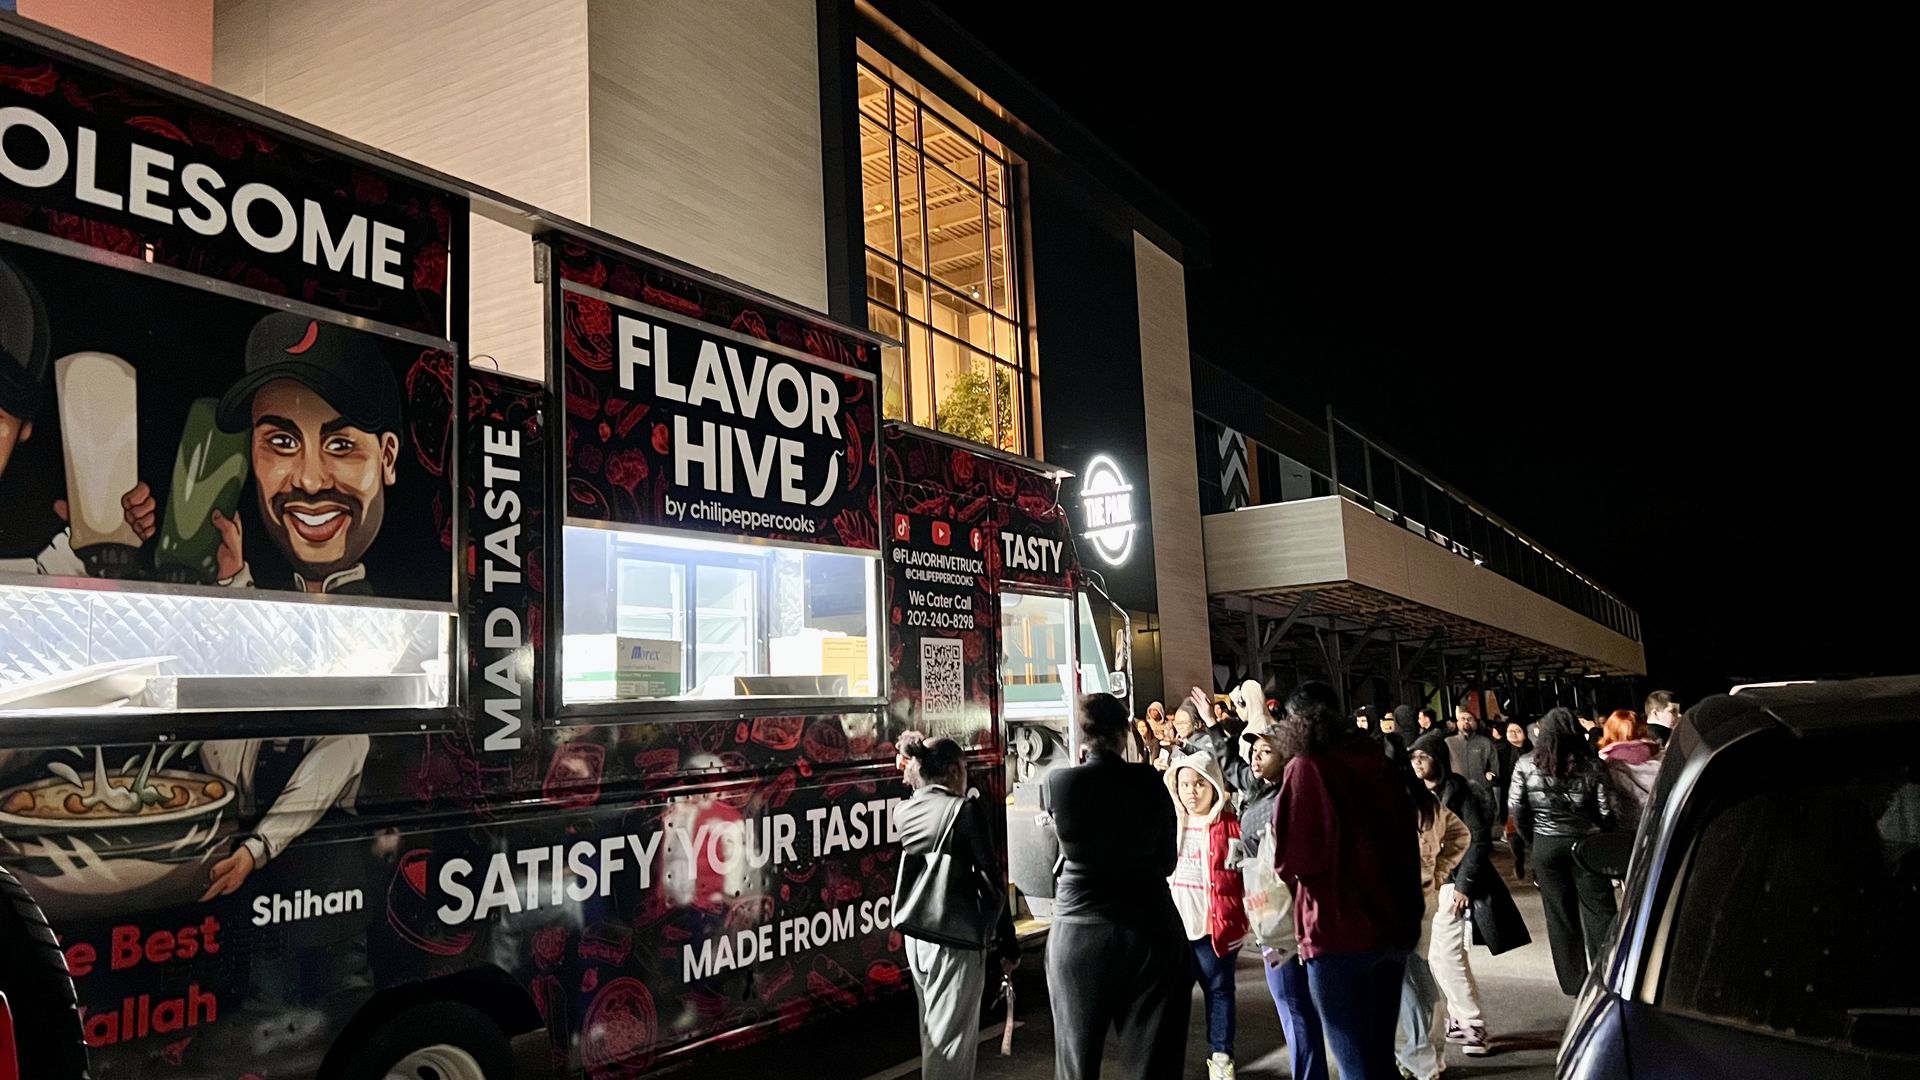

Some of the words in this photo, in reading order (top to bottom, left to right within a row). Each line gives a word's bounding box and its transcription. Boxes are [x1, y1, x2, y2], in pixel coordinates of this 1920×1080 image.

[0, 106, 406, 291] OLESOME
[618, 314, 842, 440] FLAVOR
[673, 415, 807, 506] HIVE
[484, 424, 521, 593] TASTE
[665, 495, 687, 522] by
[690, 500, 816, 534] chilipeppercooks
[892, 547, 984, 575] @FLAVORHIVETRUCK
[904, 567, 975, 587] @CHILIPEPPERCOOKS
[1001, 531, 1063, 574] TASTY
[907, 610, 974, 630] 202-240-8298
[908, 589, 925, 606] We
[926, 591, 953, 609] Cater
[954, 594, 973, 611] Call
[484, 606, 522, 751] MAD
[436, 829, 663, 926] SATISFY
[674, 813, 798, 881] YOUR
[251, 885, 364, 927] Shihan
[111, 915, 221, 971] Best
[681, 922, 774, 983] MADE
[779, 904, 855, 956] FROM
[77, 983, 218, 1048] allah
